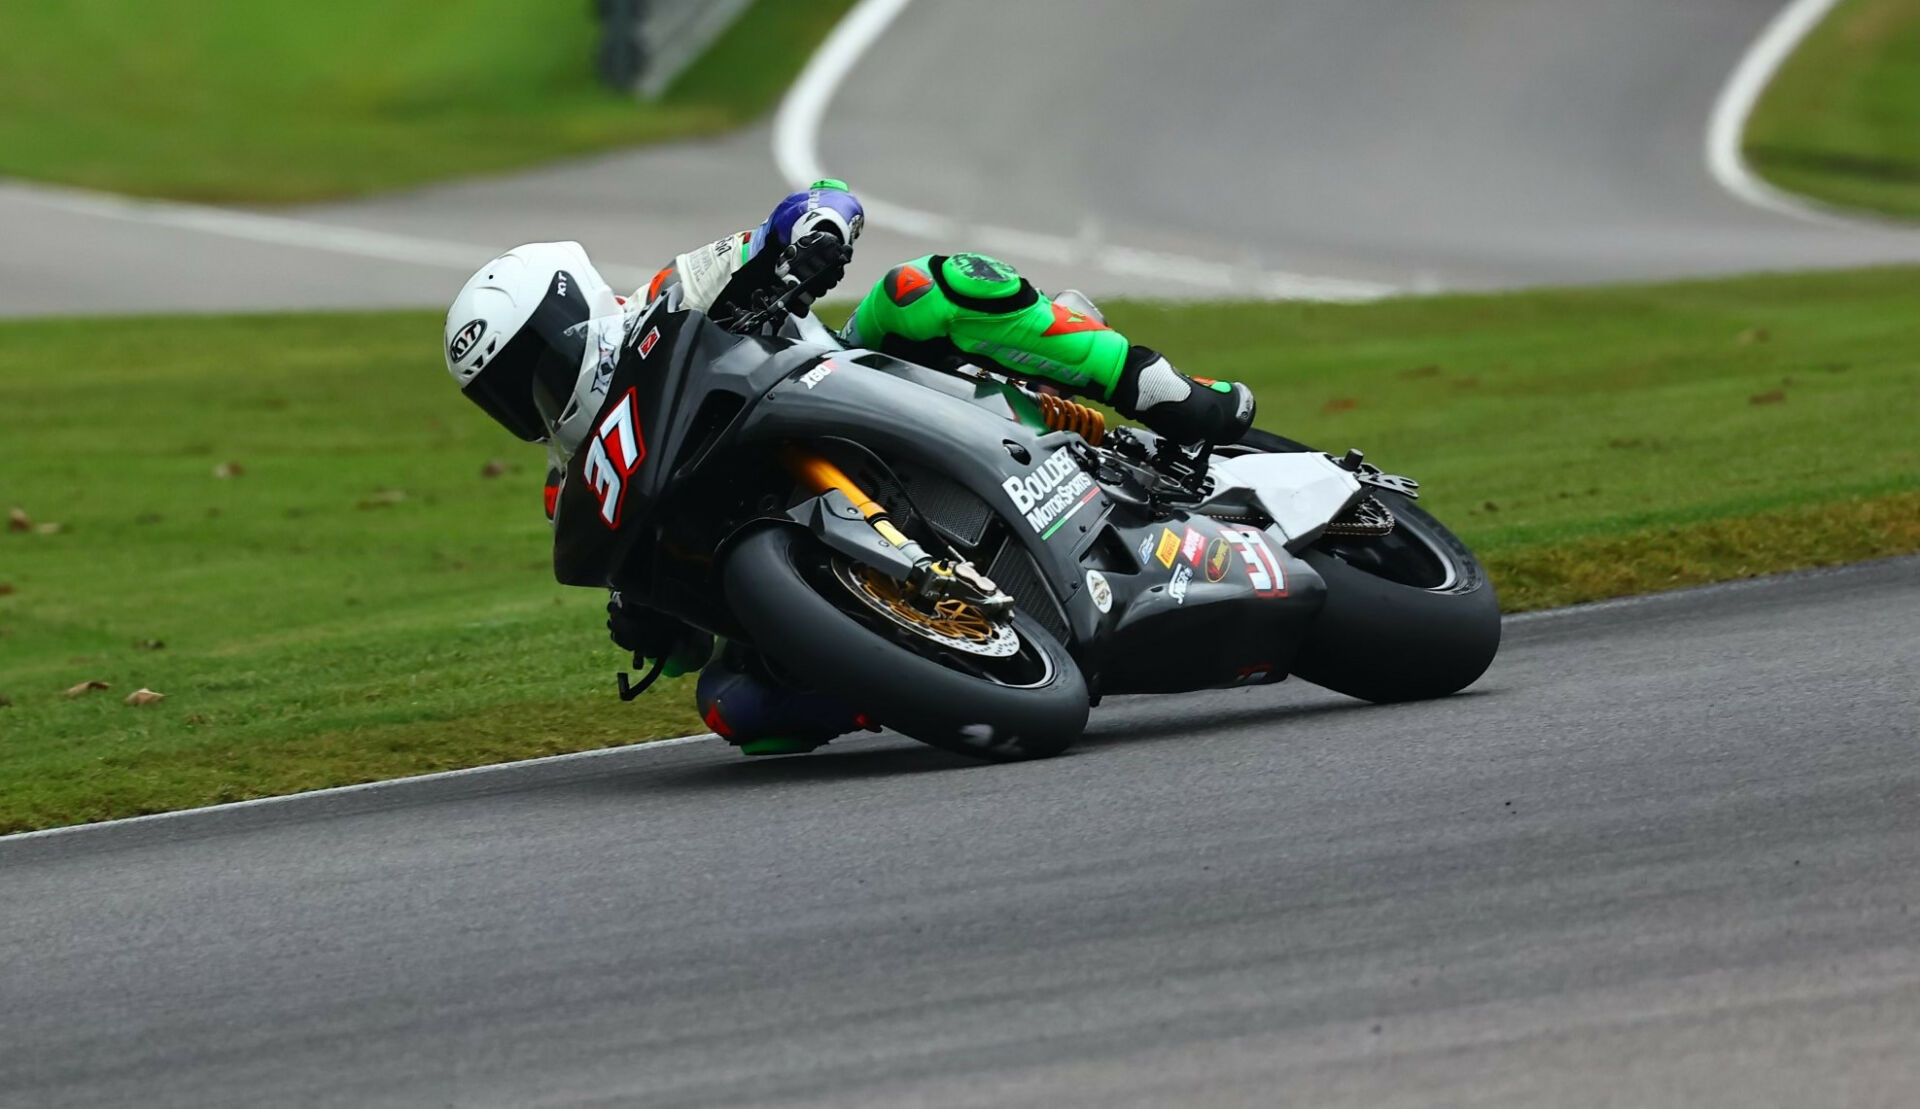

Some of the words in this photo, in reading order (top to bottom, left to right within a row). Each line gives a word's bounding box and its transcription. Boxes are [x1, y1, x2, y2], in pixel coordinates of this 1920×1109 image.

[557, 271, 567, 297] KYT
[452, 321, 481, 359] KYT
[583, 390, 643, 527] 37
[1002, 445, 1077, 515] BOULDER
[1026, 471, 1091, 533] MOTORSPORTS
[1219, 529, 1285, 592] 37
